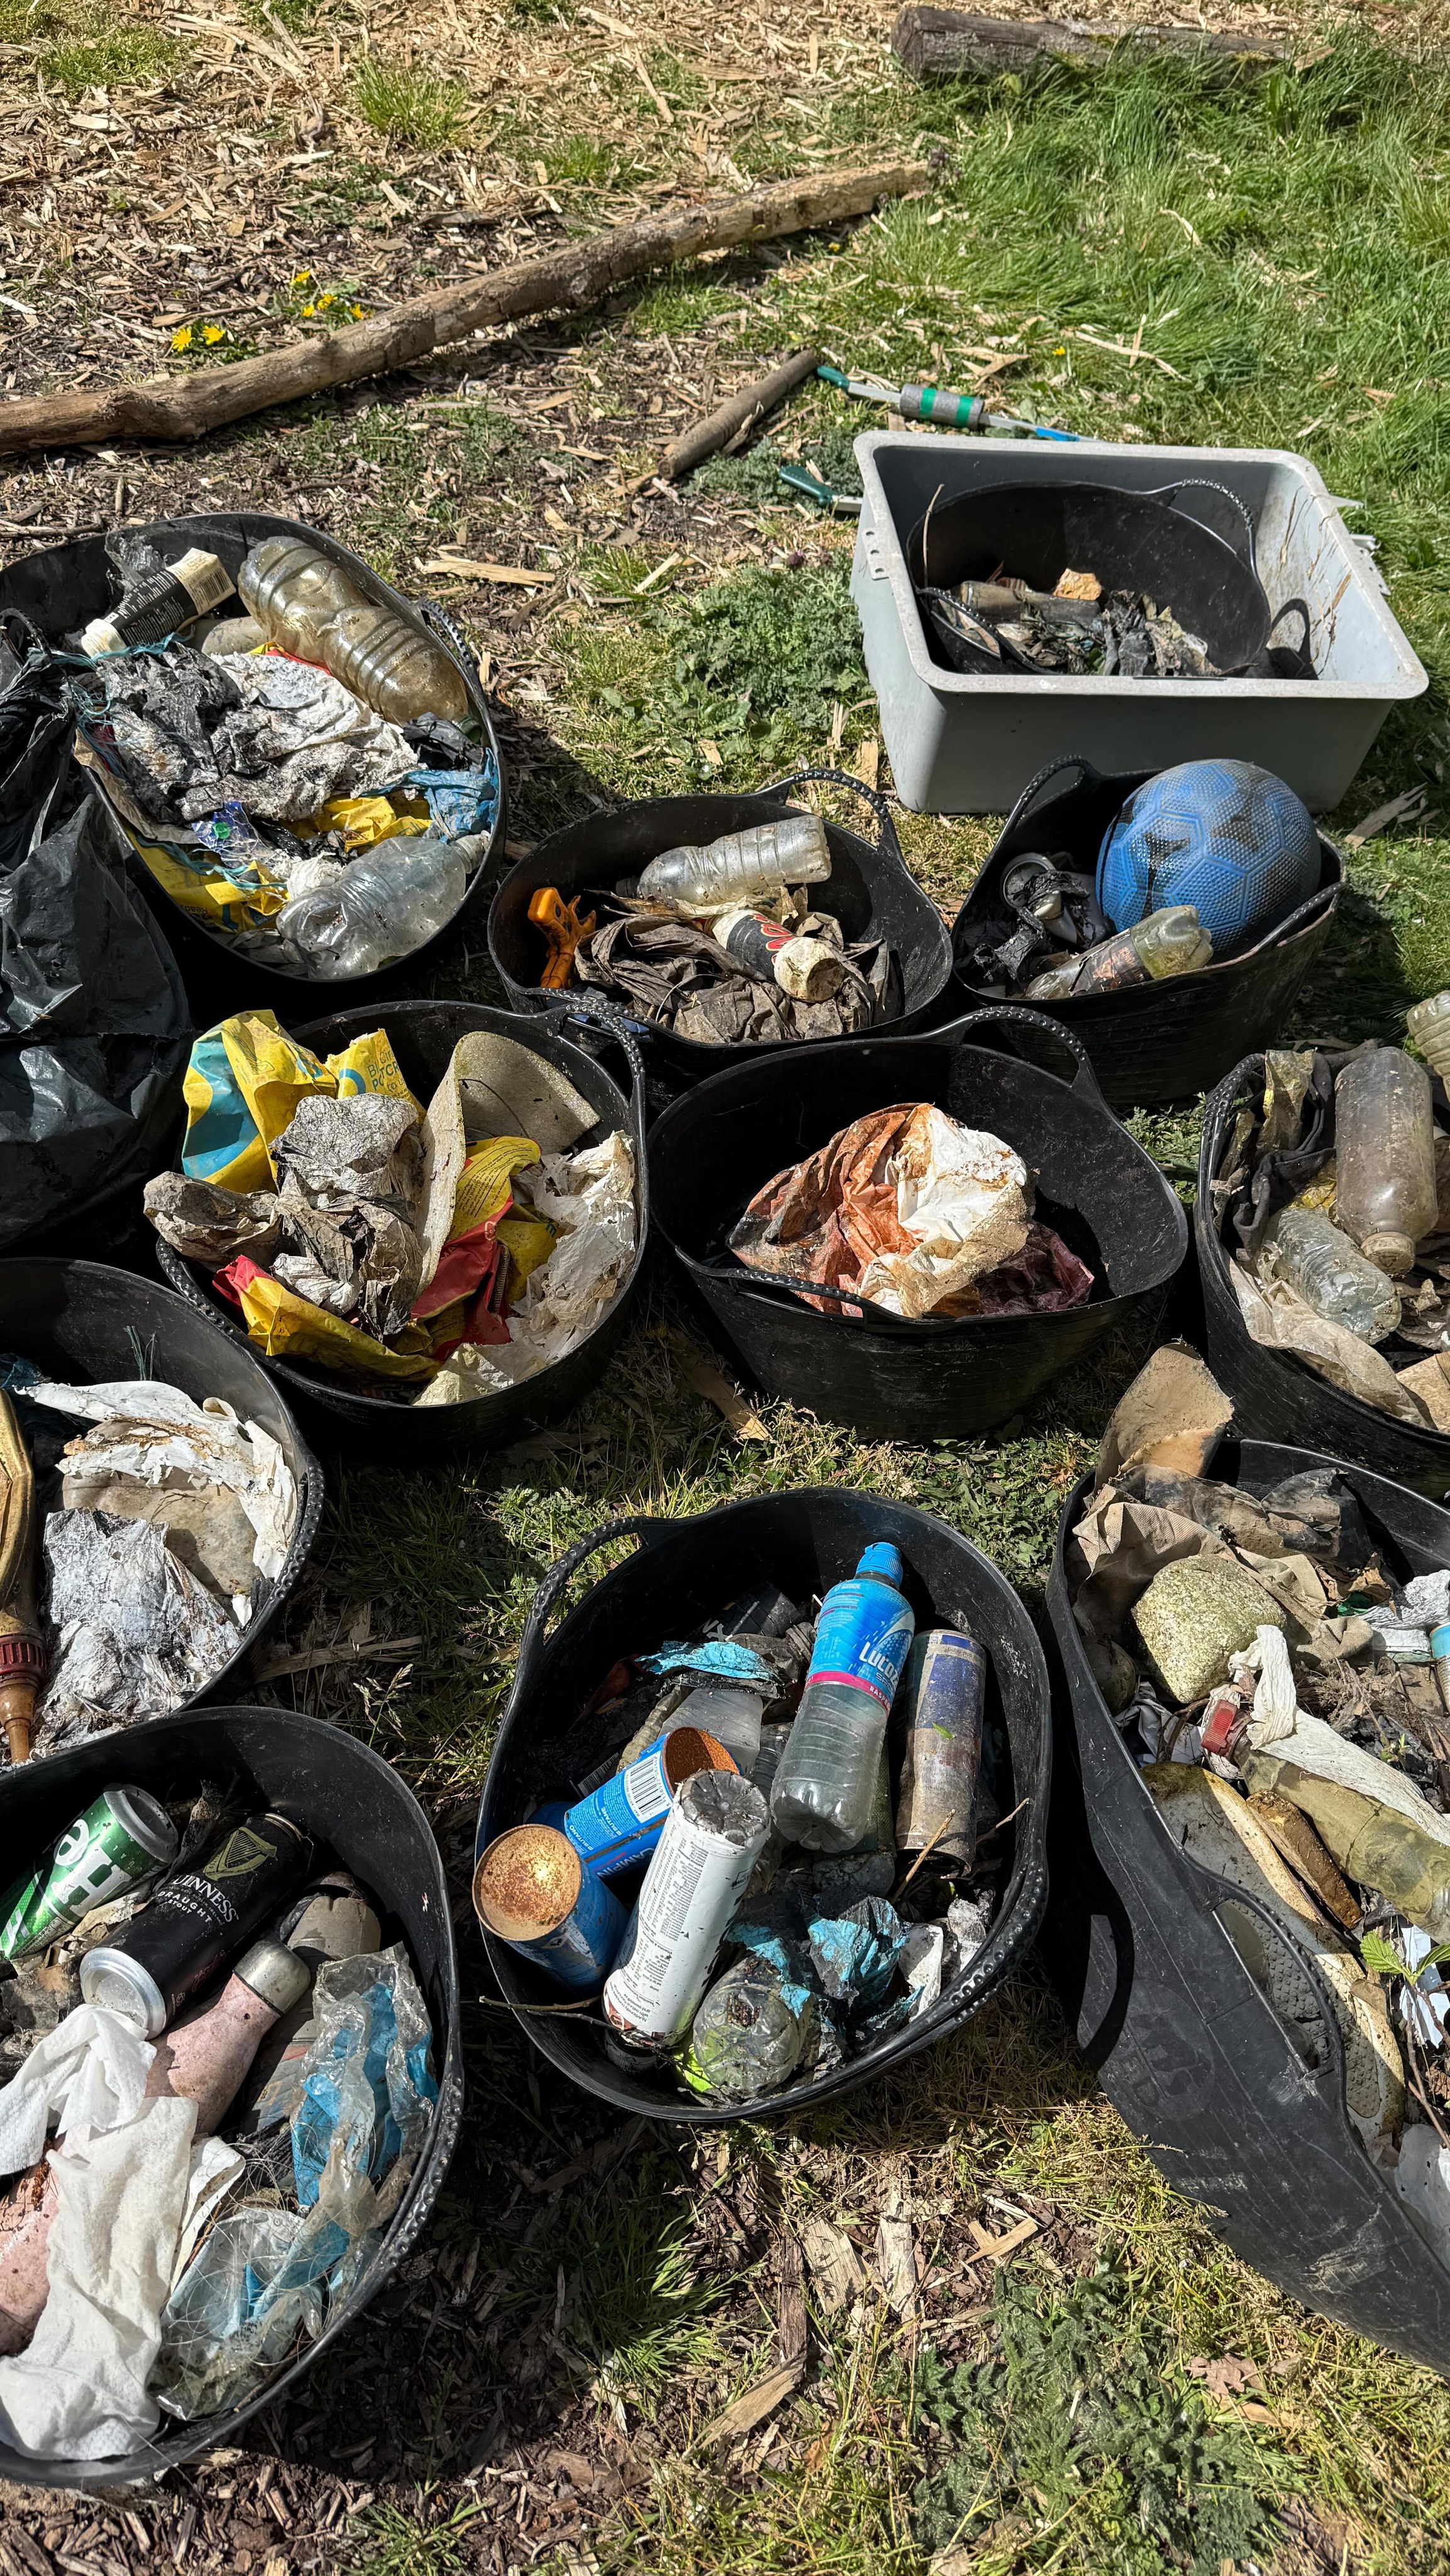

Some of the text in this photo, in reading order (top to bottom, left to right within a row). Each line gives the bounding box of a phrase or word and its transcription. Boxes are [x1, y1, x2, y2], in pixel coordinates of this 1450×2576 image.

[601, 1807, 618, 1833] BUTANE
[94, 1821, 144, 1872] QUALIY
[569, 1824, 589, 1848] BUTANO
[157, 1890, 213, 1923] DRAUGHT
[167, 1899, 192, 1914] STOUT
[172, 1875, 237, 1922] UINNESS
